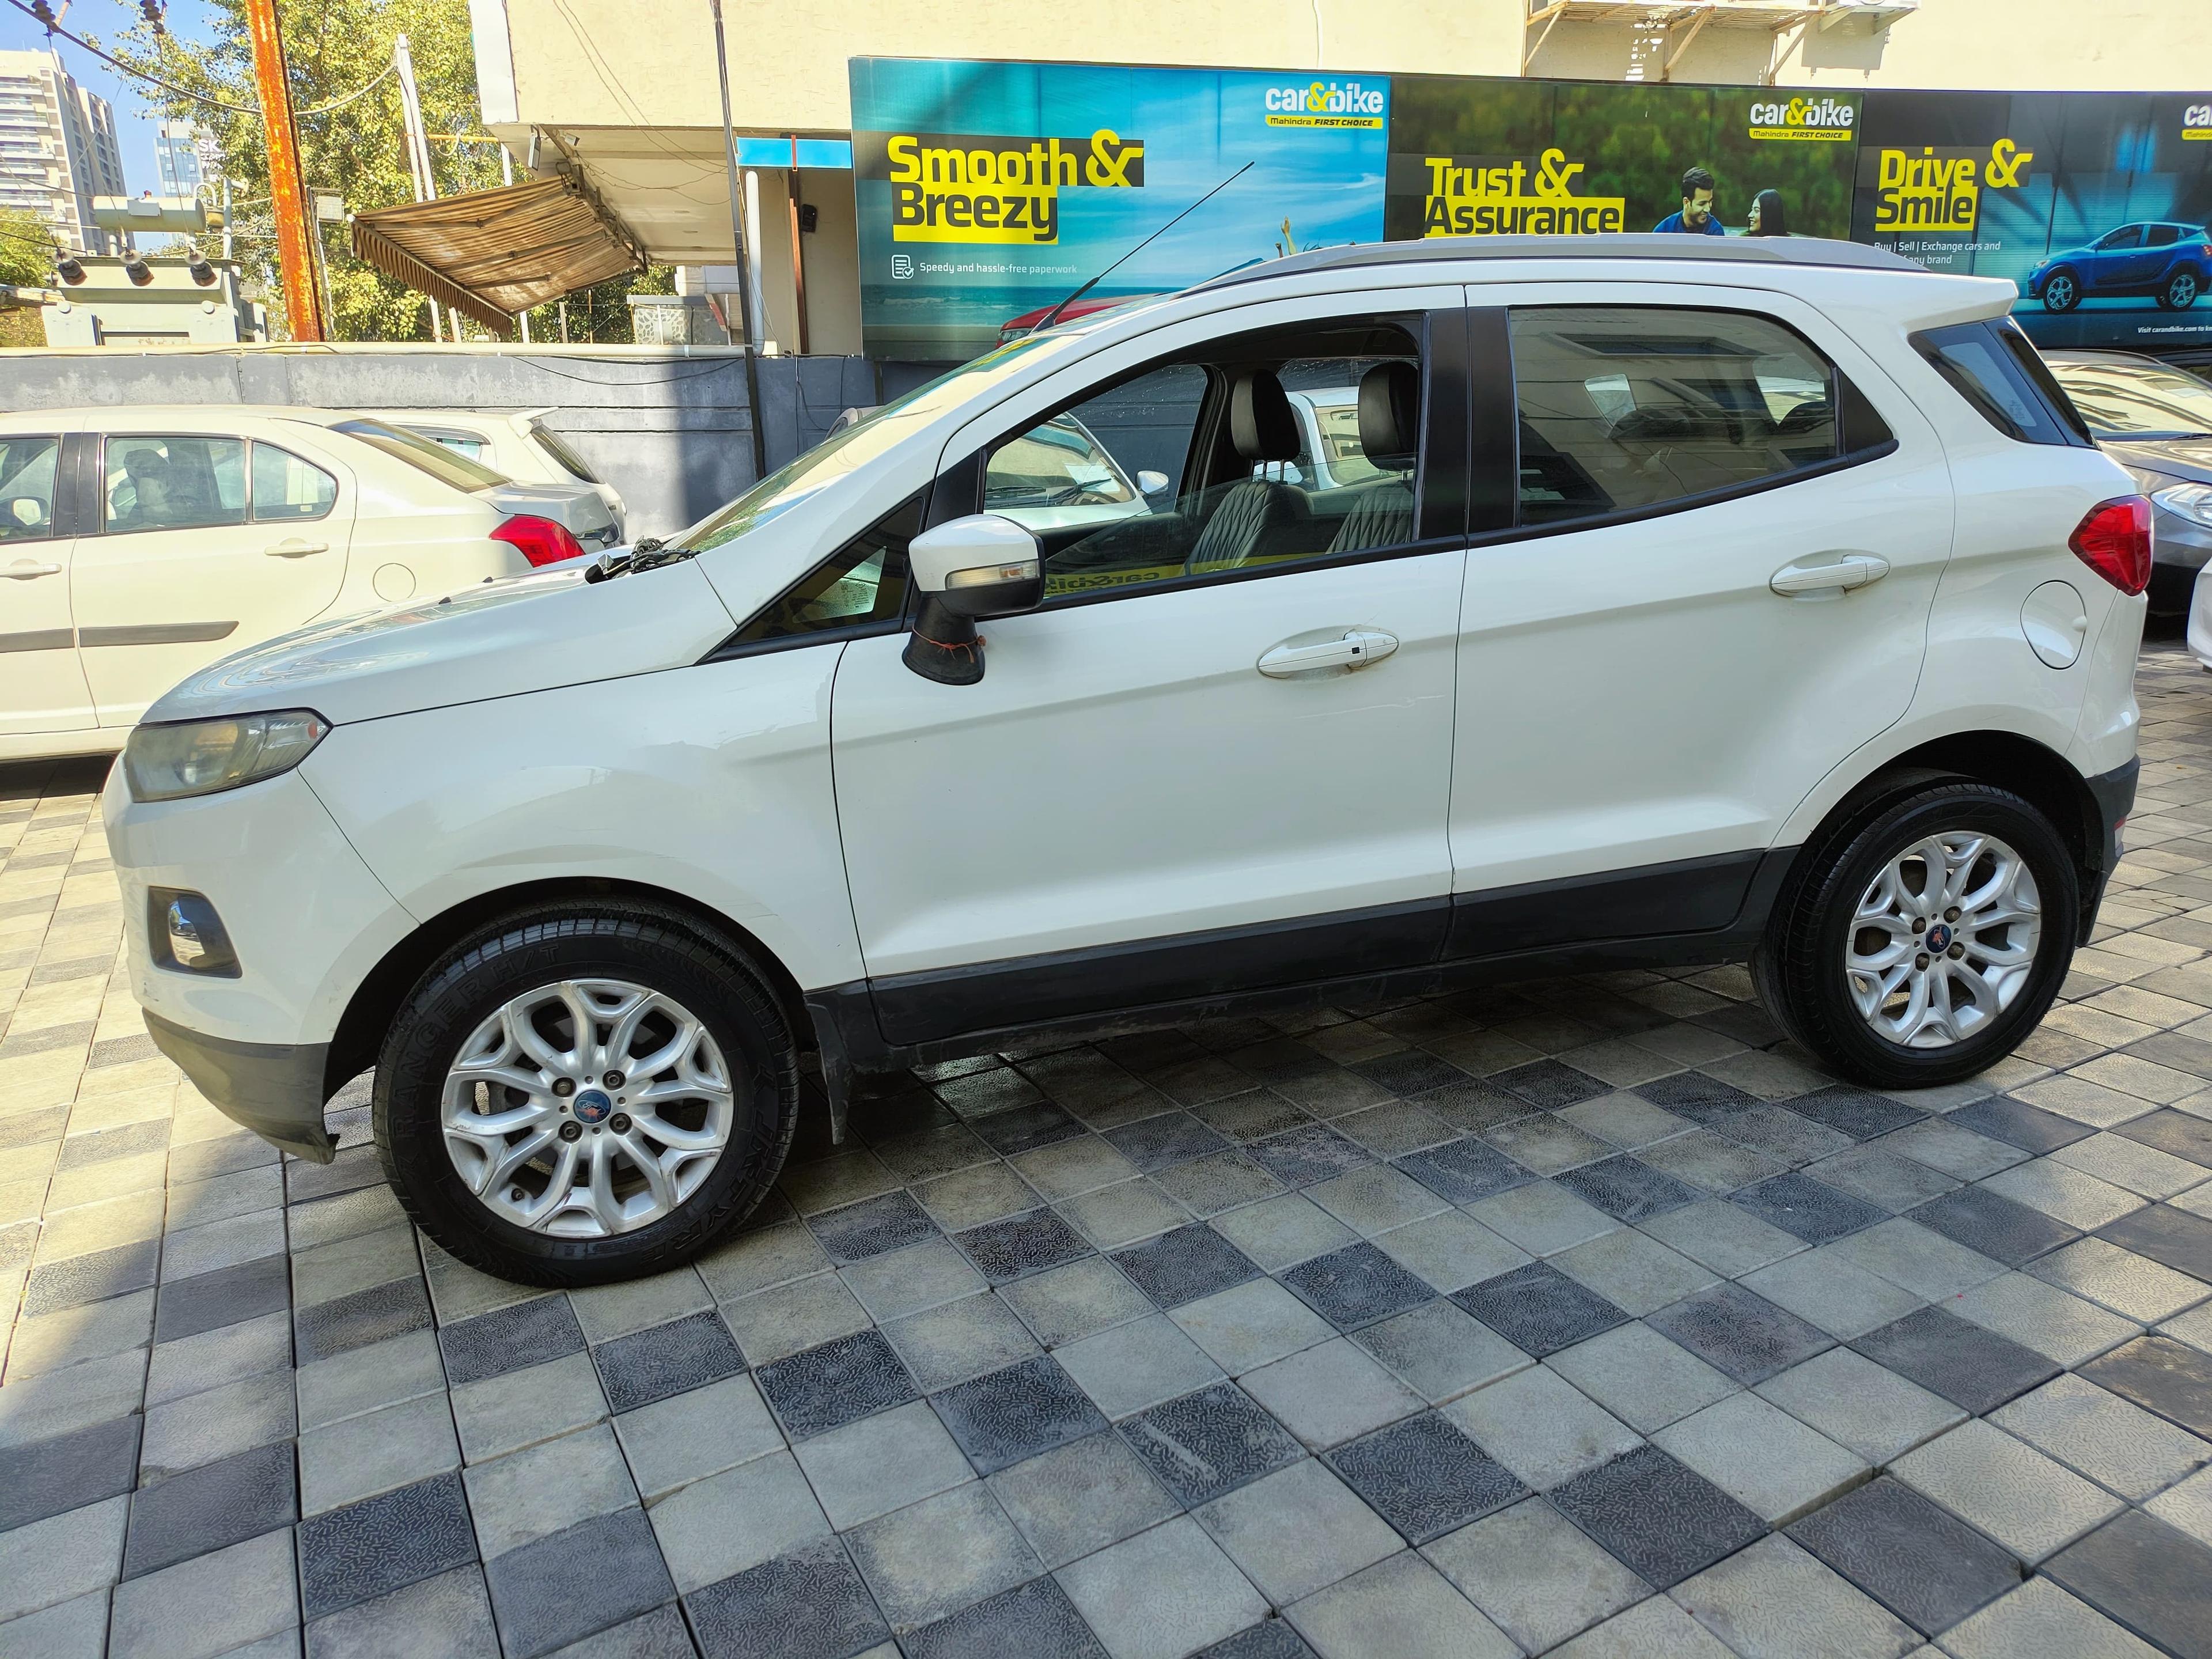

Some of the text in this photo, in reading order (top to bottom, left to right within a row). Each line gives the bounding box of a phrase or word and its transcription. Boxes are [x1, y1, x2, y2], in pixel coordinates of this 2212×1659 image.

[1265, 81, 1384, 114] car&bike
[1749, 97, 1854, 127] car&bike
[1270, 118, 1312, 126] Mahindra
[1314, 118, 1340, 126] FIRST
[2184, 104, 2212, 127] ca
[887, 129, 1145, 187] Smooth &
[1425, 148, 1585, 198] Trust &
[1878, 138, 2034, 188] Drive &
[891, 182, 1058, 241] Breezy
[1424, 196, 1620, 234] Assurance
[1876, 187, 1973, 225] Smile
[1874, 242, 1892, 252] Buy
[1898, 241, 1915, 251] Sell
[1921, 241, 1963, 253] Exchange
[1964, 242, 1982, 251] cars
[1983, 241, 2001, 251] and
[1927, 254, 1952, 264] brand
[919, 262, 1078, 275] Speedy and hassle-free paperwork
